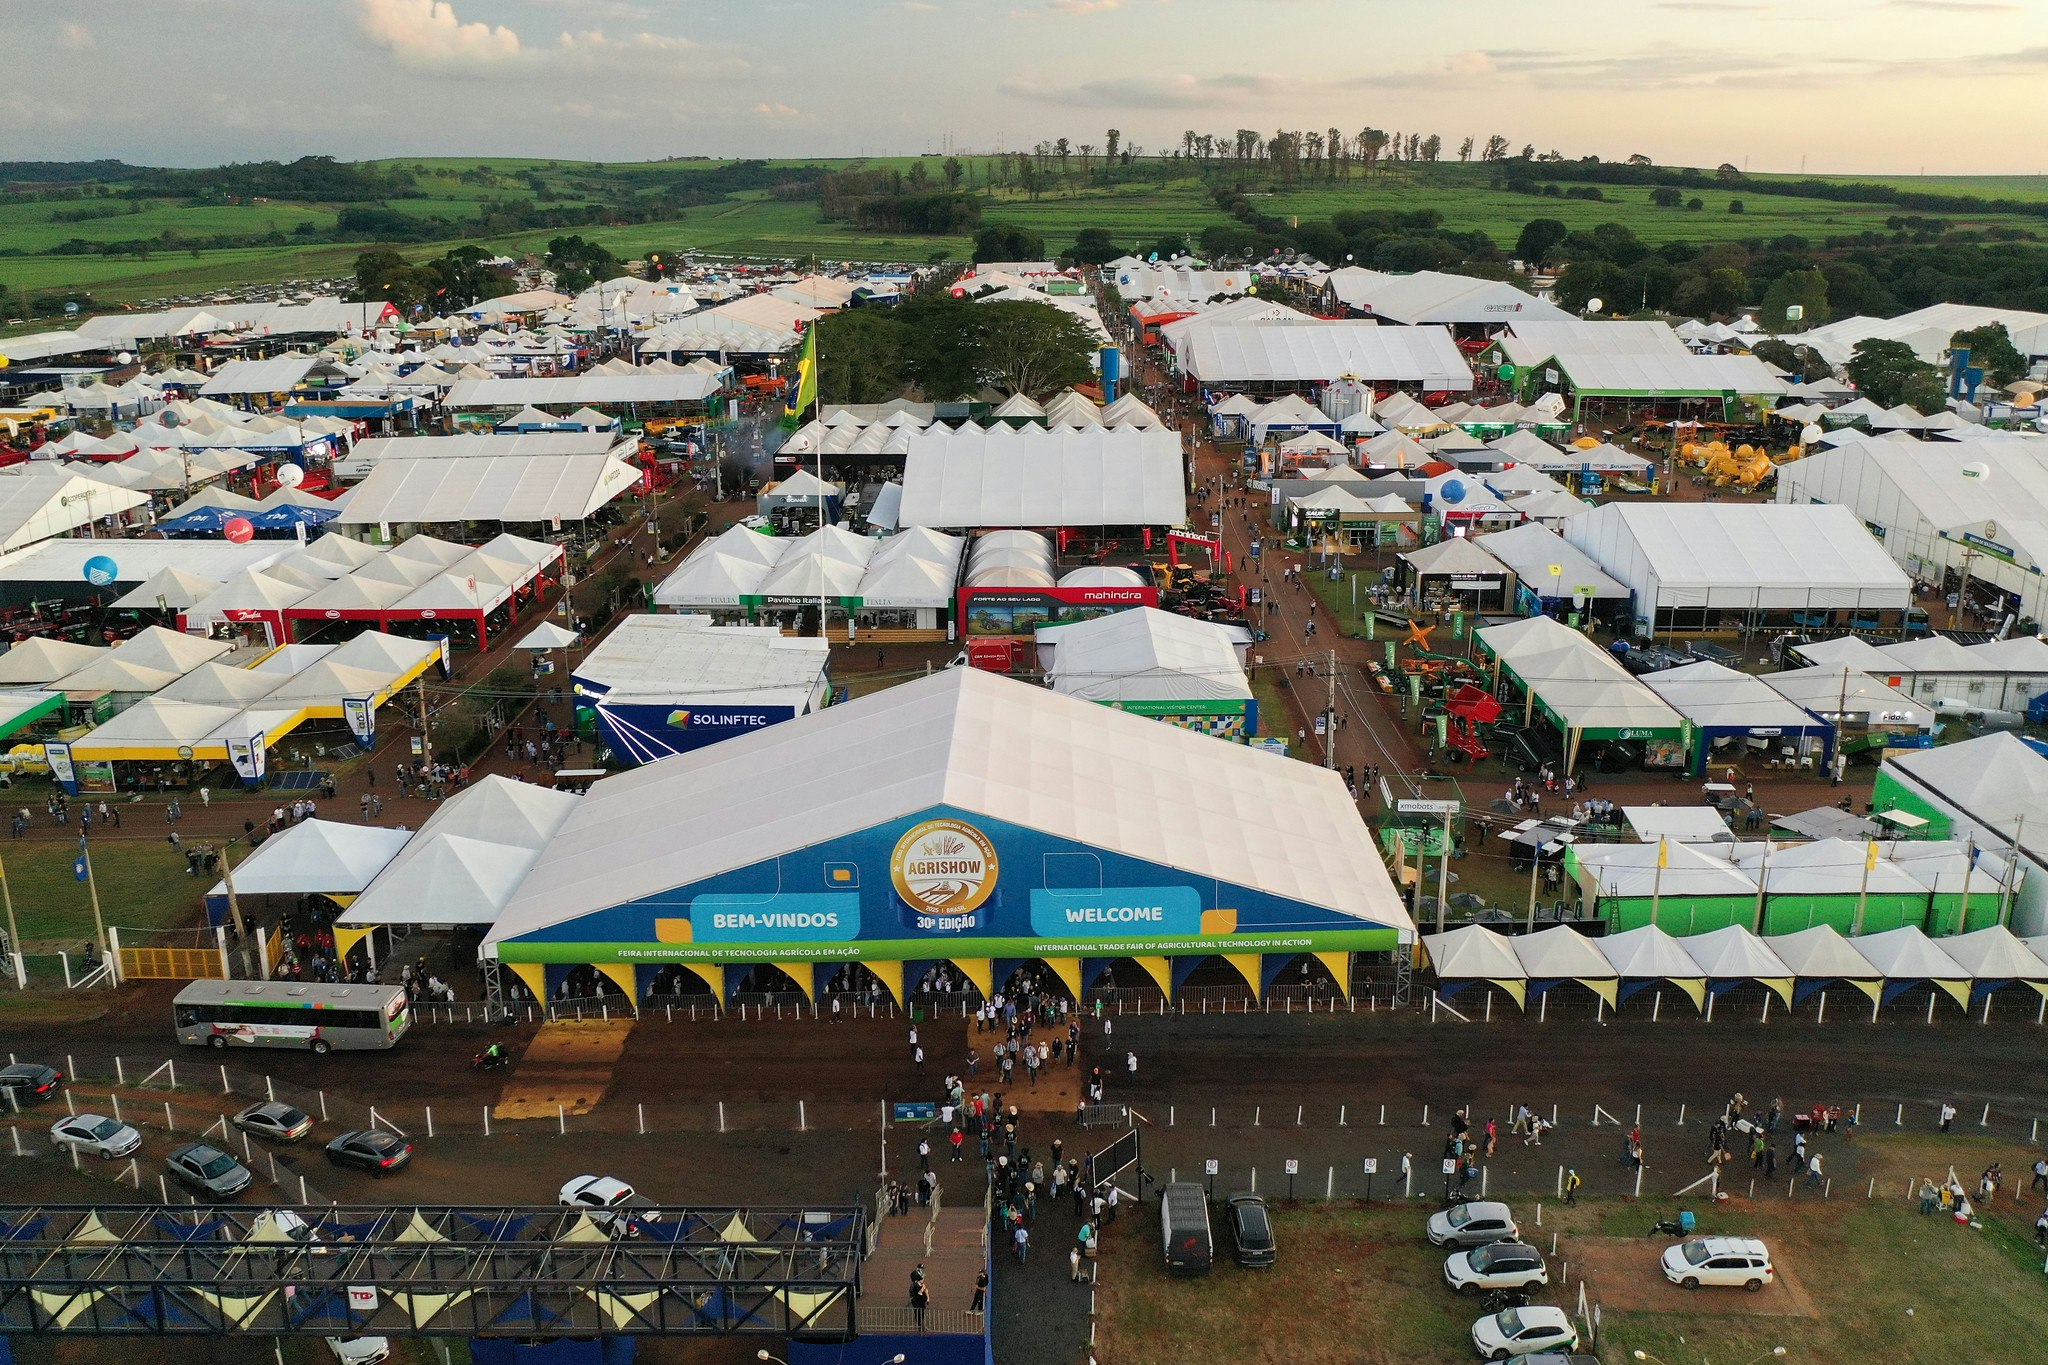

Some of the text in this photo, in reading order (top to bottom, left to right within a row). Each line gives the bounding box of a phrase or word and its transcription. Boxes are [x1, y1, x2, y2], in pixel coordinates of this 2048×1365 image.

[767, 596, 801, 604] Pavilhão
[1084, 591, 1142, 600] mahindra
[693, 714, 767, 726] SOLINFTEC
[1400, 802, 1434, 810] xmobots
[908, 861, 982, 875] AGRISHOW
[925, 905, 967, 914] 2025 BRASIL
[1065, 907, 1163, 922] WELCOME
[713, 912, 839, 928] BEM-VINDOS
[917, 914, 975, 933] 30ª EDIÇÃO
[1157, 941, 1216, 949] AGRICULTURAL
[1218, 940, 1271, 948] TECHNOLOGY
[643, 949, 711, 957] INTERNACIONAL
[712, 949, 723, 957] DE
[724, 949, 778, 957] TECNOLOGIA
[779, 947, 821, 956] AGRÍCOLA
[837, 947, 860, 957] AÇÃO
